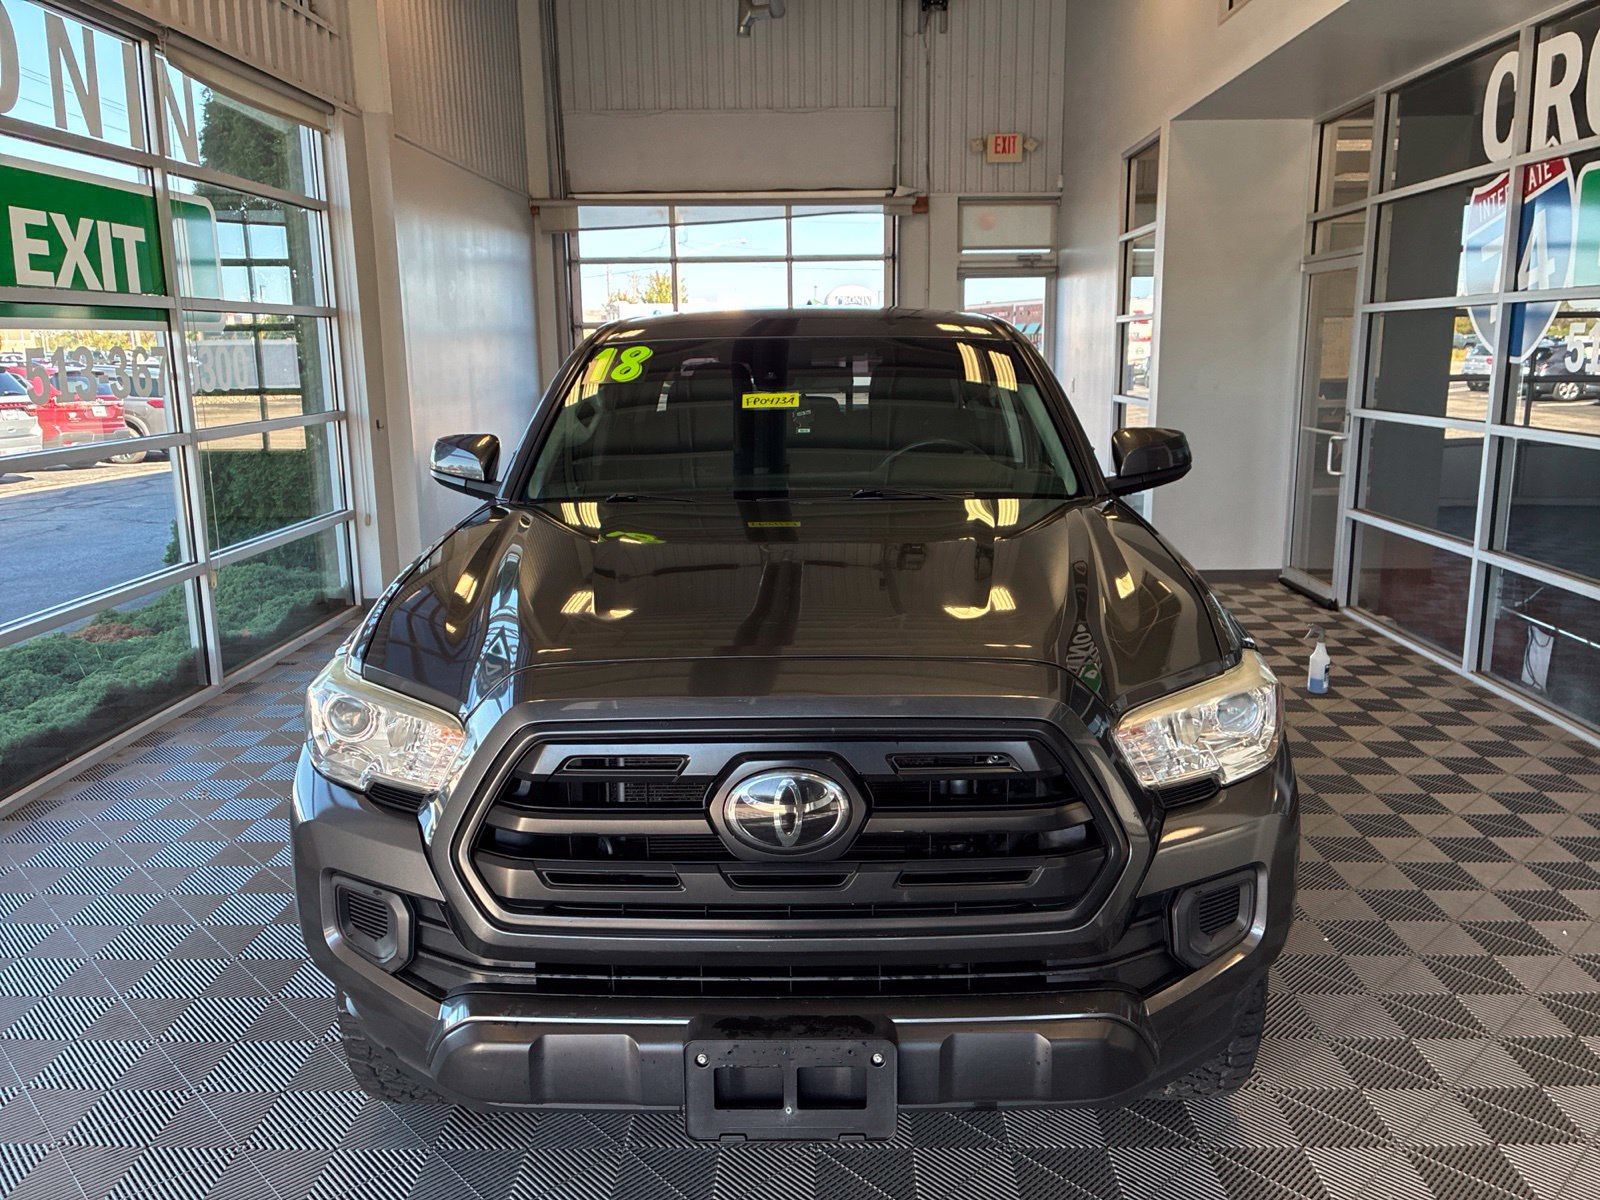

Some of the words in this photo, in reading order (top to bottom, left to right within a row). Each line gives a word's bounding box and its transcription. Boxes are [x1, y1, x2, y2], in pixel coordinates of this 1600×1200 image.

[1482, 28, 1600, 162] CR
[994, 135, 1018, 154] EXIT
[1478, 162, 1552, 222] INTEATE
[8, 206, 146, 294] EXIT
[1481, 208, 1555, 324] 74
[590, 345, 653, 382] 18
